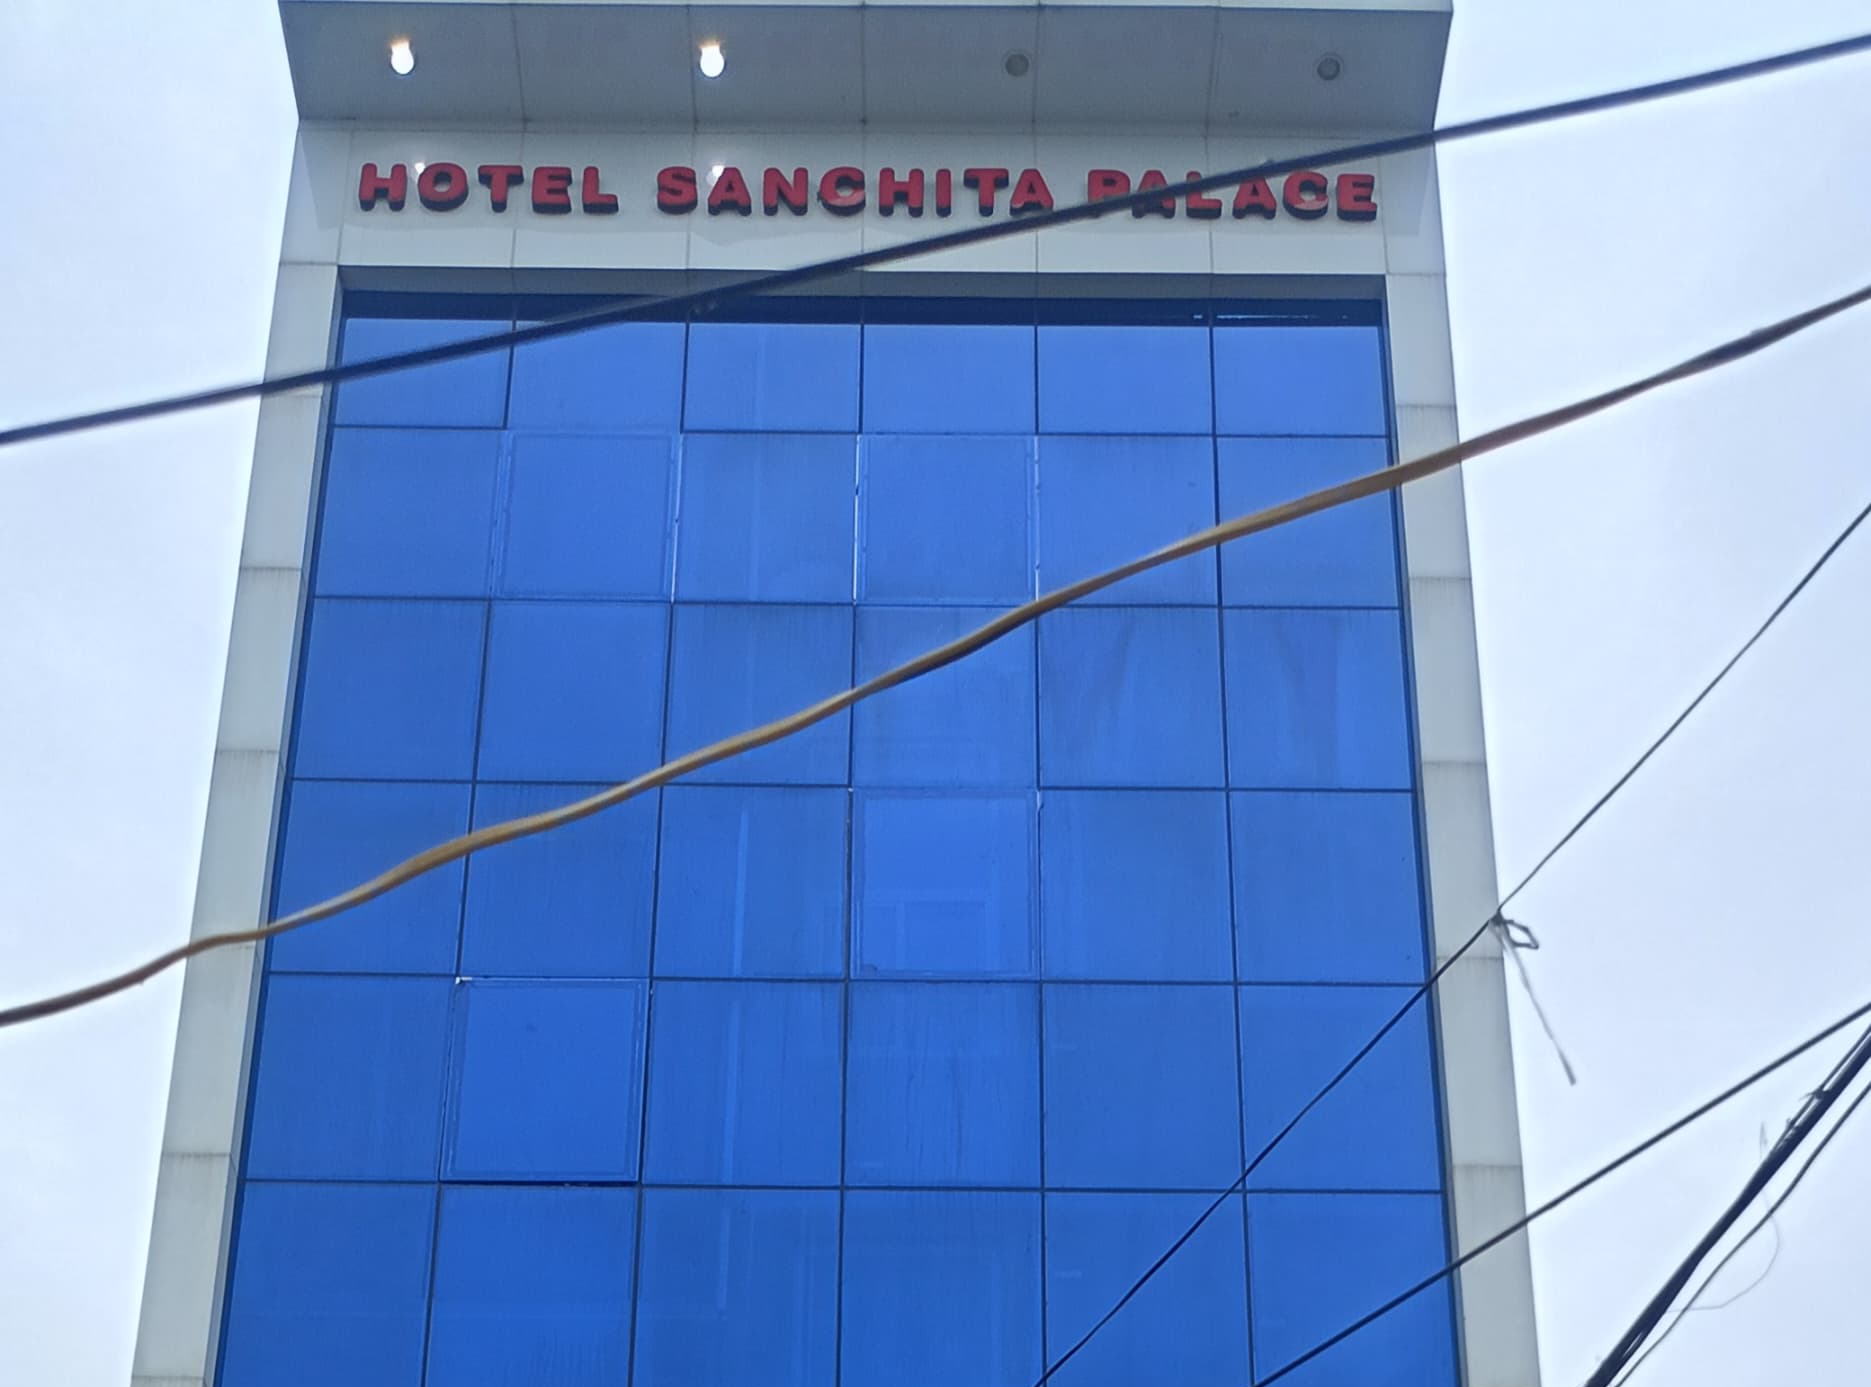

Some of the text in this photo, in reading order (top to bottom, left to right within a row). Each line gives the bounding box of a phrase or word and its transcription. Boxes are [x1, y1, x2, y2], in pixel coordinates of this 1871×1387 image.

[359, 162, 1377, 221] HOTEL SANCHITA PALACE
